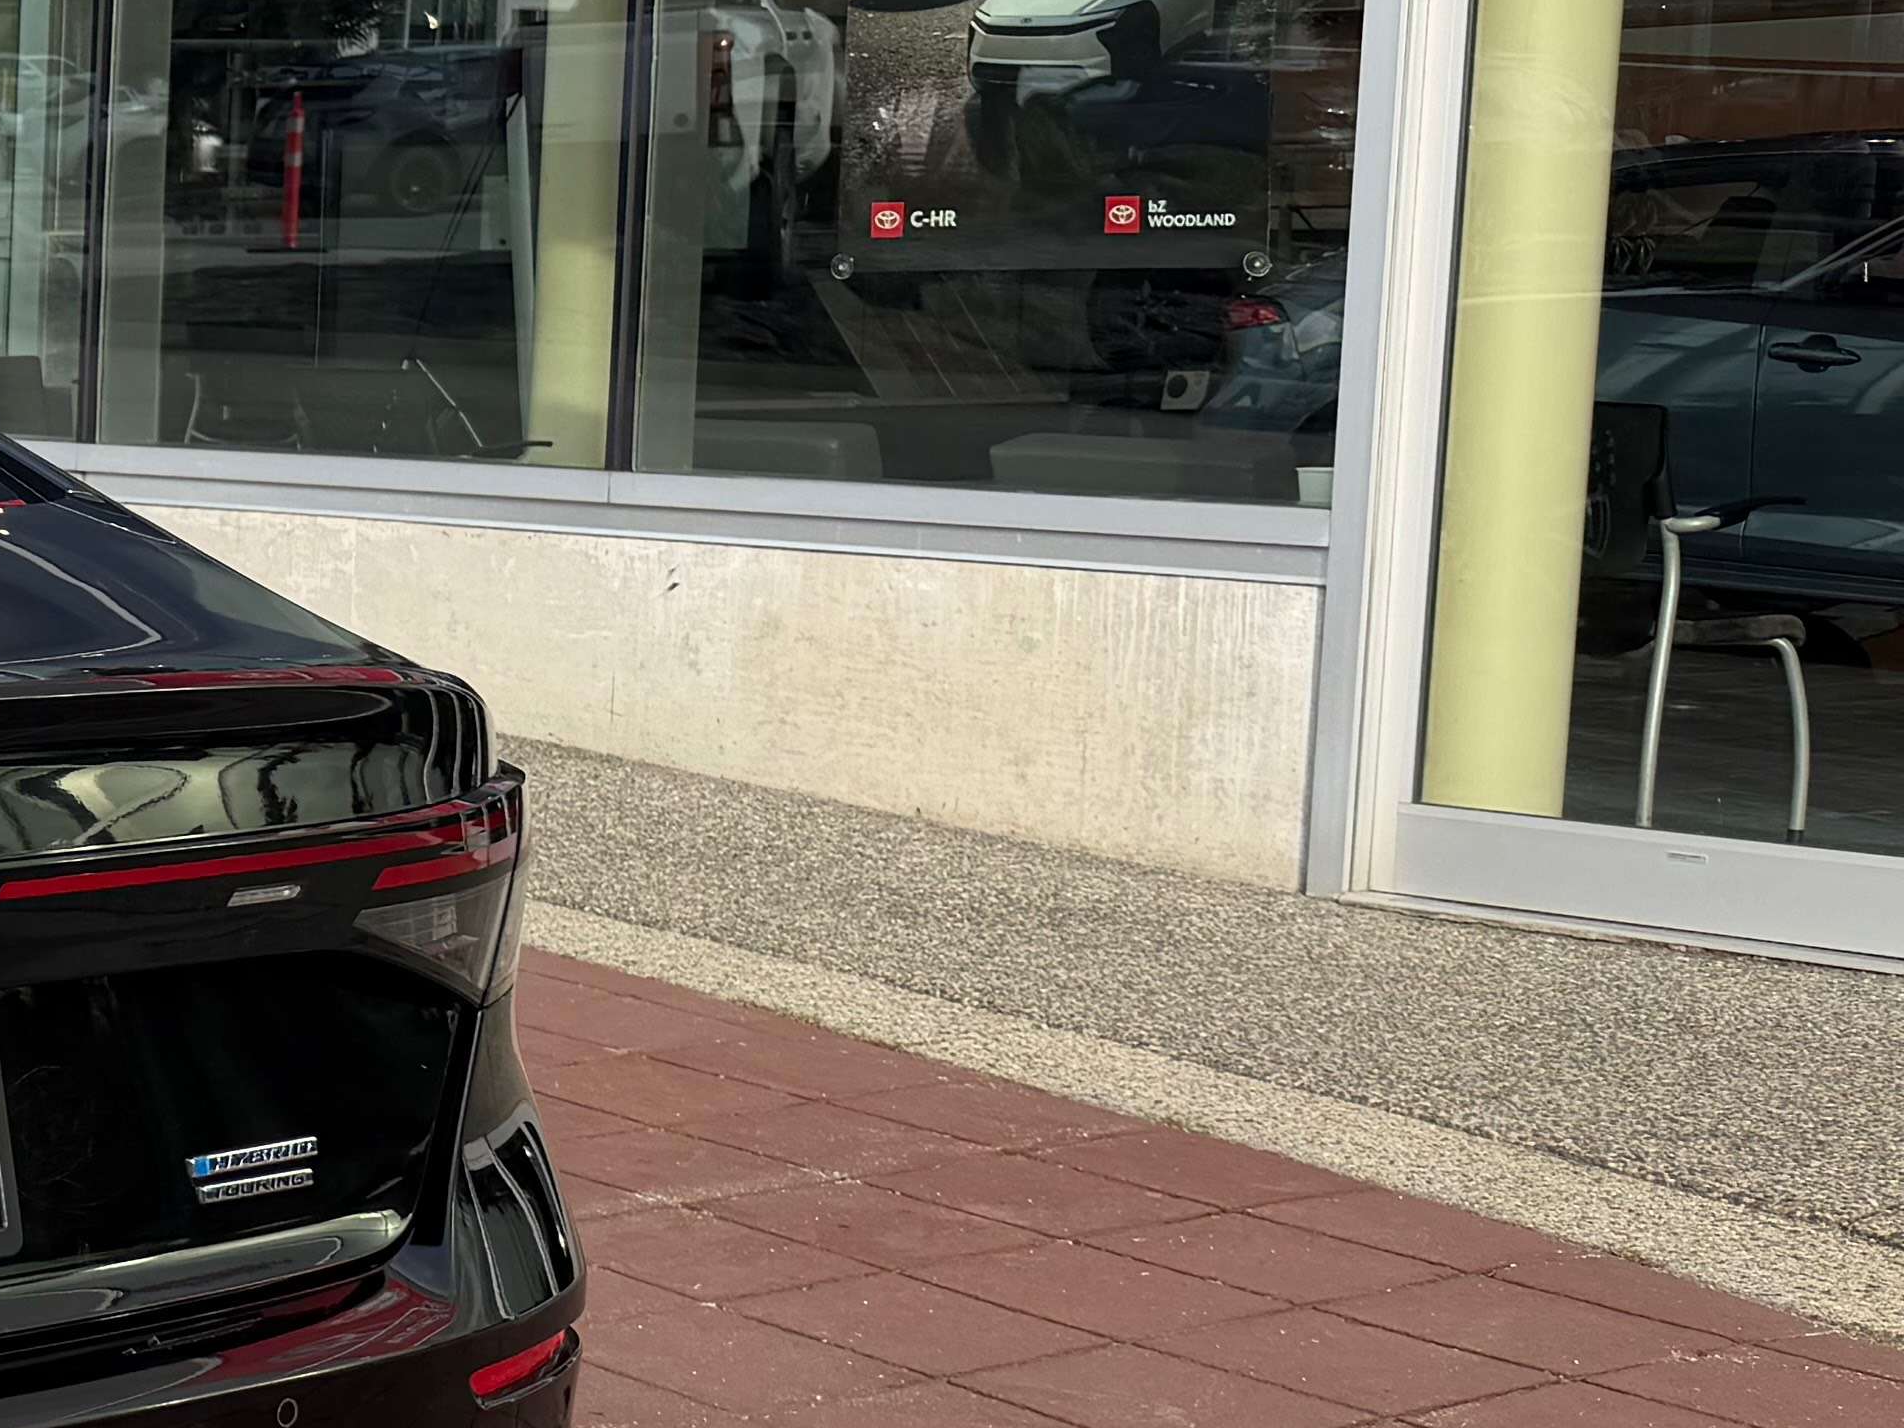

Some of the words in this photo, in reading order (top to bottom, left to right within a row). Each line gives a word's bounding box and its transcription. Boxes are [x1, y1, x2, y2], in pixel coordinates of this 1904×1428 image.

[1148, 199, 1167, 213] bZ
[910, 210, 957, 228] C-HR
[1148, 214, 1236, 228] WOODLAND
[213, 1140, 314, 1170] HYBRID
[210, 1173, 305, 1199] TOURING
